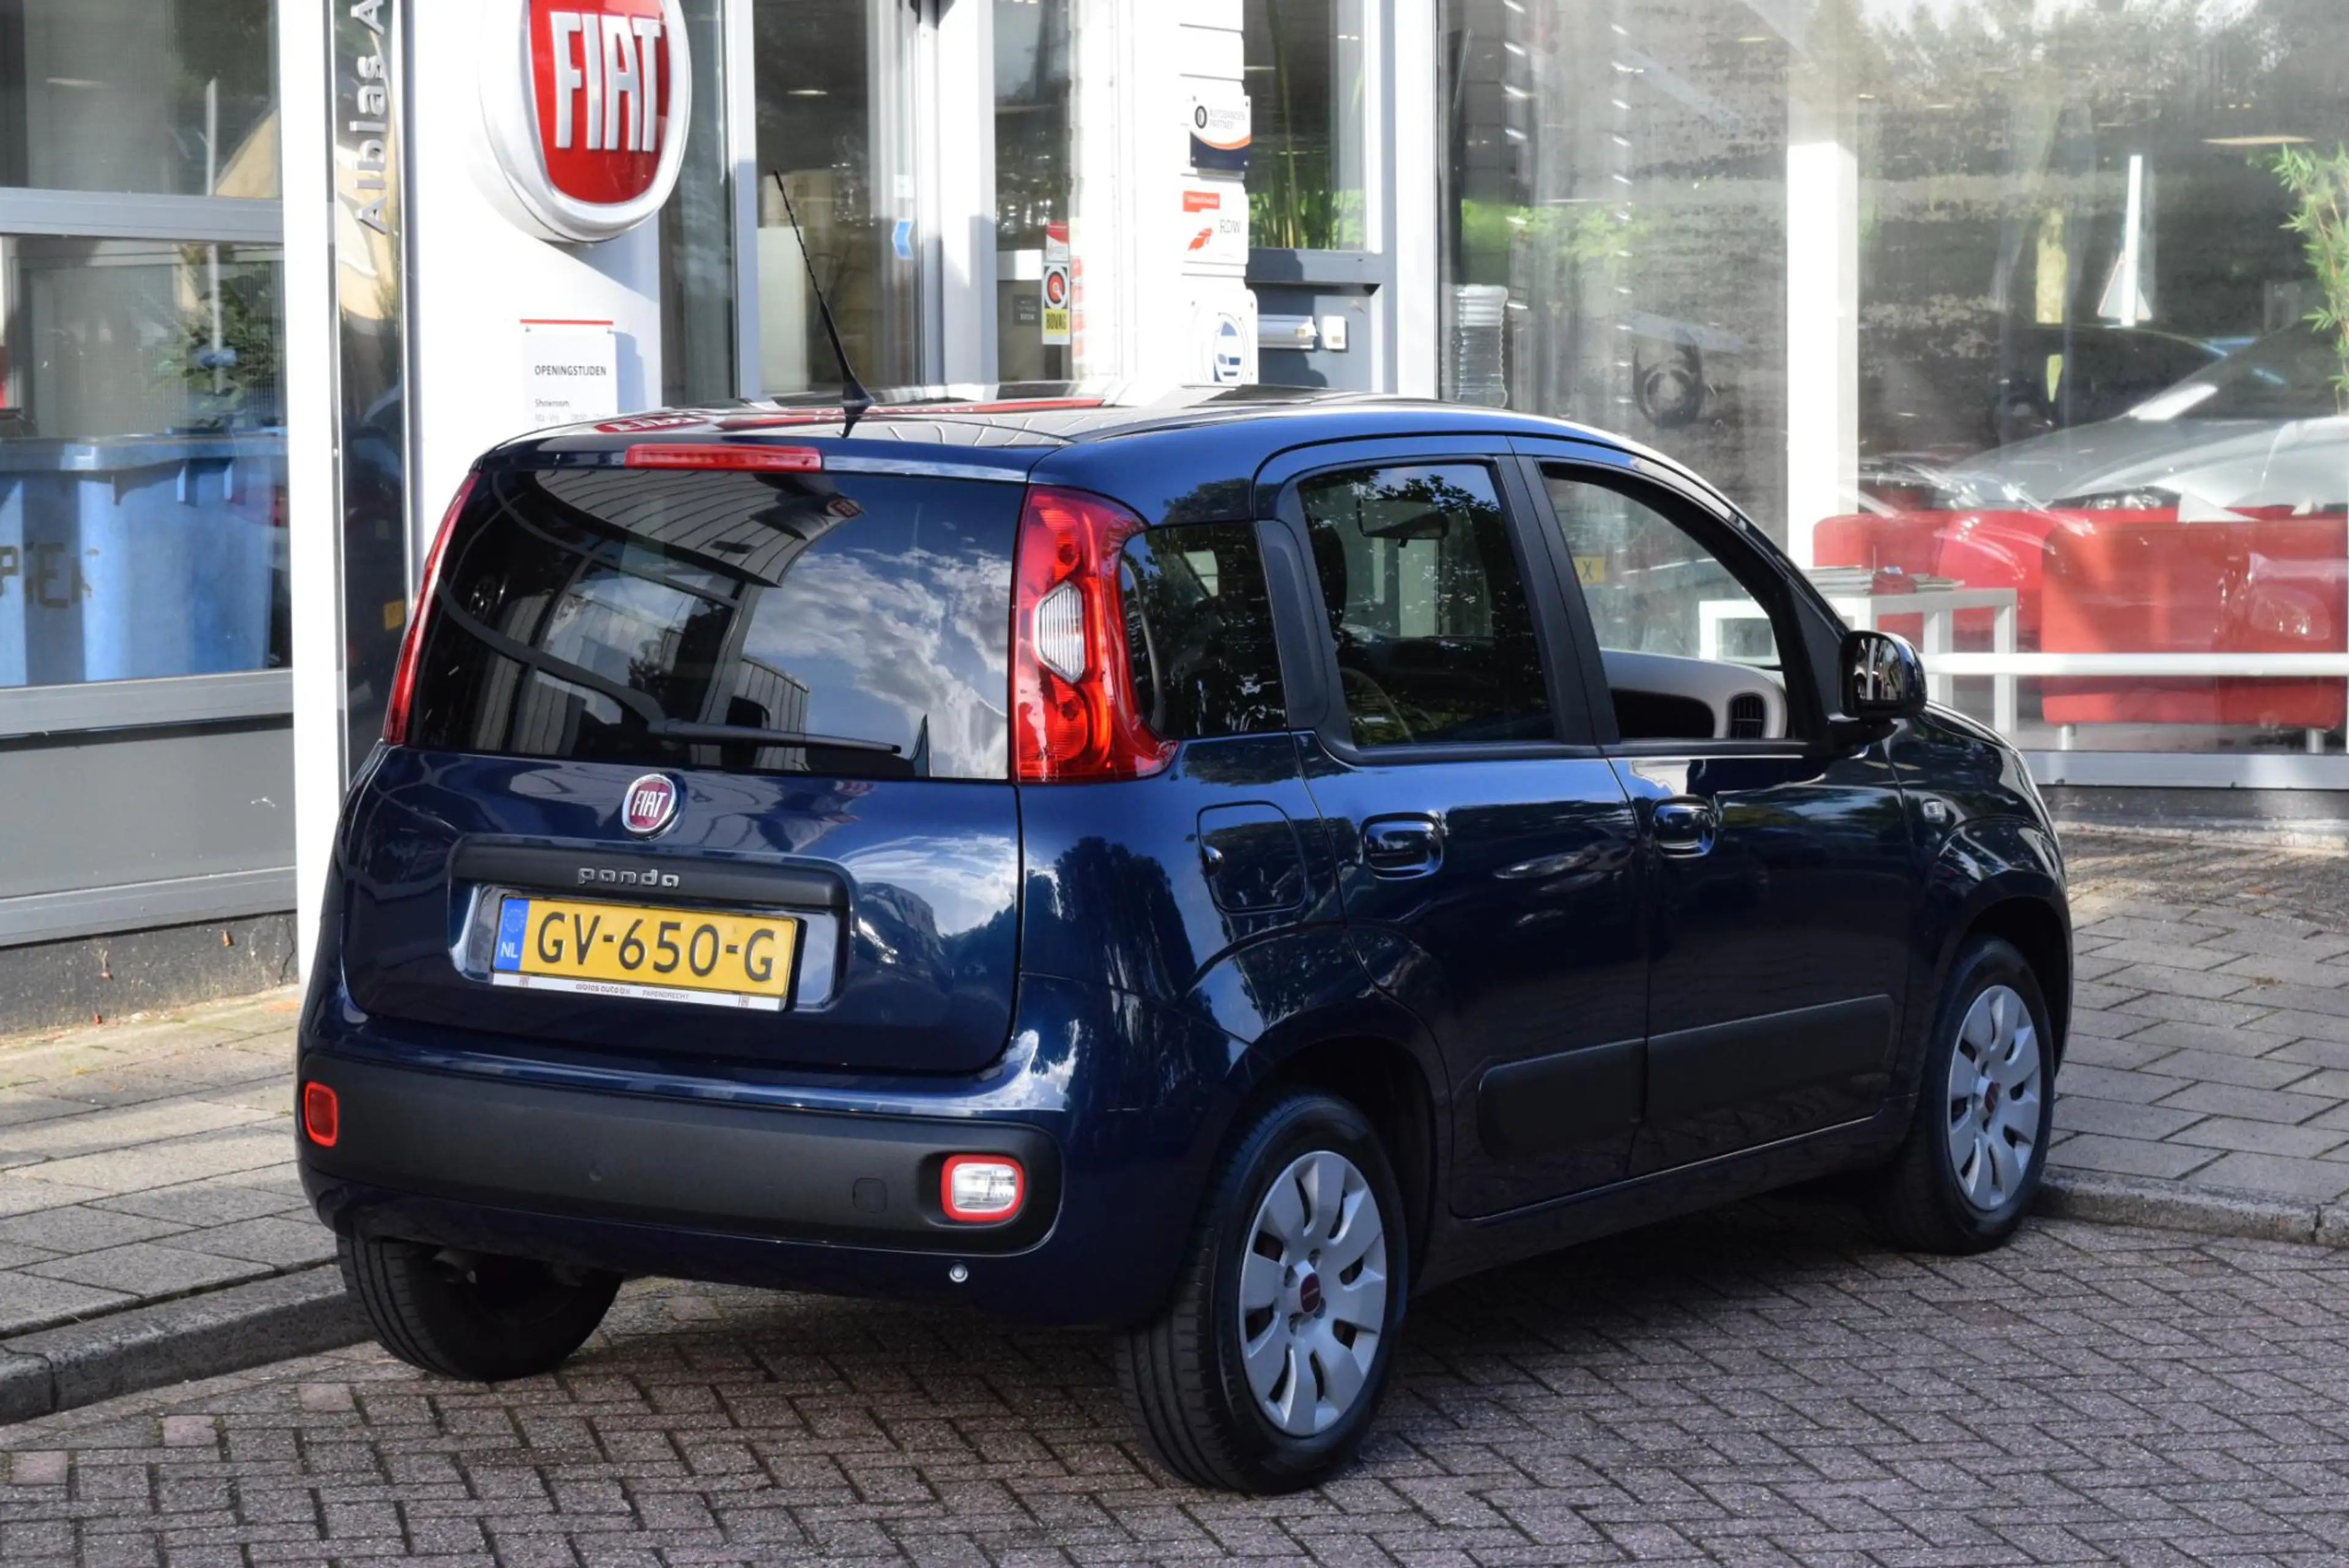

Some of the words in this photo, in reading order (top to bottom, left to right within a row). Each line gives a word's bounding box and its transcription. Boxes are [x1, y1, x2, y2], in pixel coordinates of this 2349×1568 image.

[550, 11, 661, 152] FIAT
[349, 56, 387, 235] Alblas
[1220, 219, 1241, 233] RDW
[1046, 313, 1067, 330] BOVAG
[631, 790, 668, 818] FIAT
[578, 868, 679, 887] panda
[500, 942, 519, 959] NL
[538, 912, 776, 982] GV-650-G
